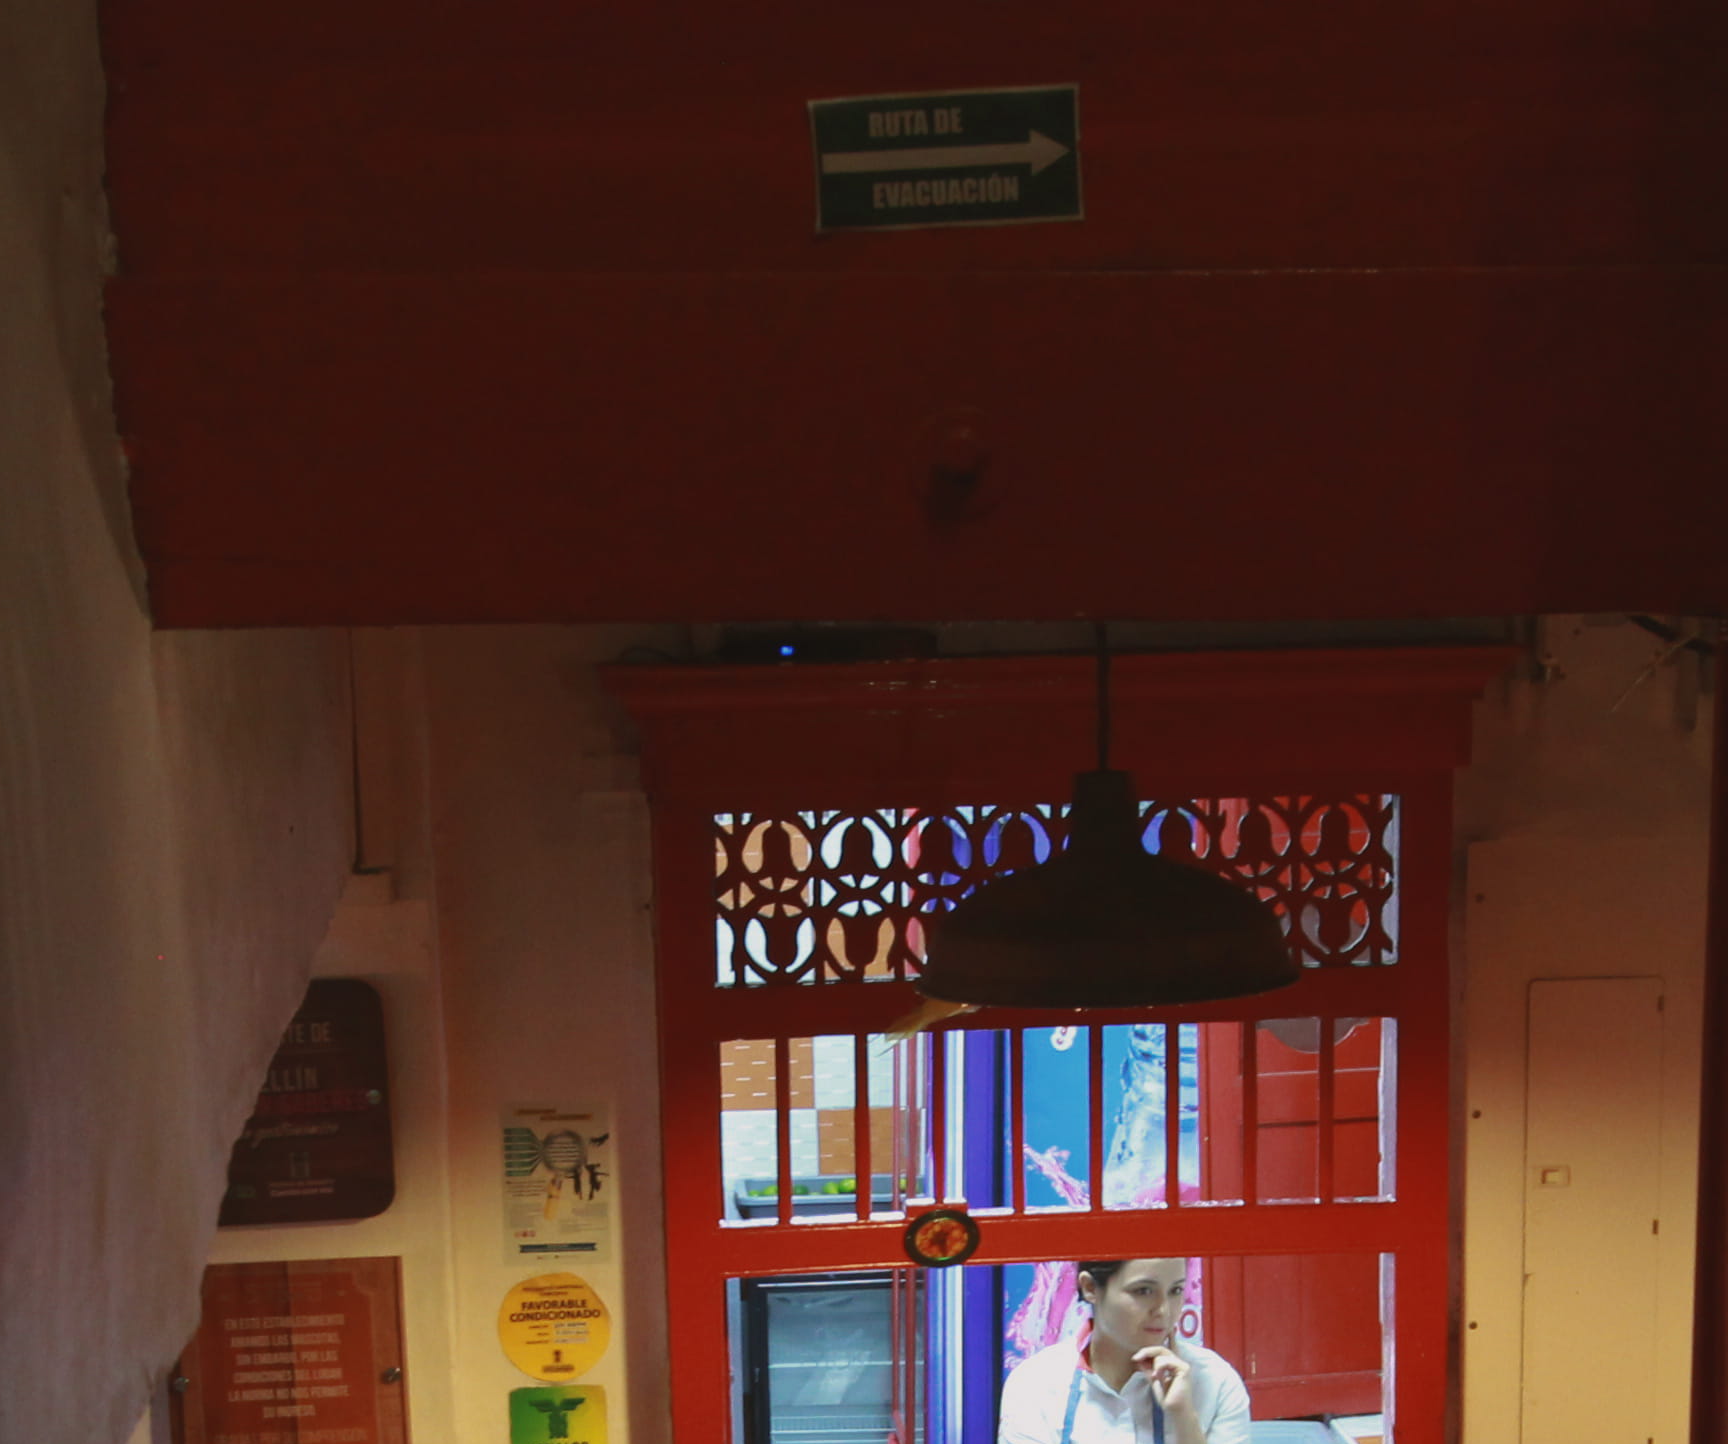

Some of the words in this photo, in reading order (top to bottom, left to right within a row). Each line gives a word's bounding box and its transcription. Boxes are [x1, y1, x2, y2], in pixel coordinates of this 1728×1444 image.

[869, 110, 928, 137] RUTA
[934, 108, 964, 134] DE
[873, 173, 1019, 209] EVACUACIÓN
[510, 1309, 601, 1322] CONDICIONADO
[521, 1299, 587, 1311] FAVORABLE
